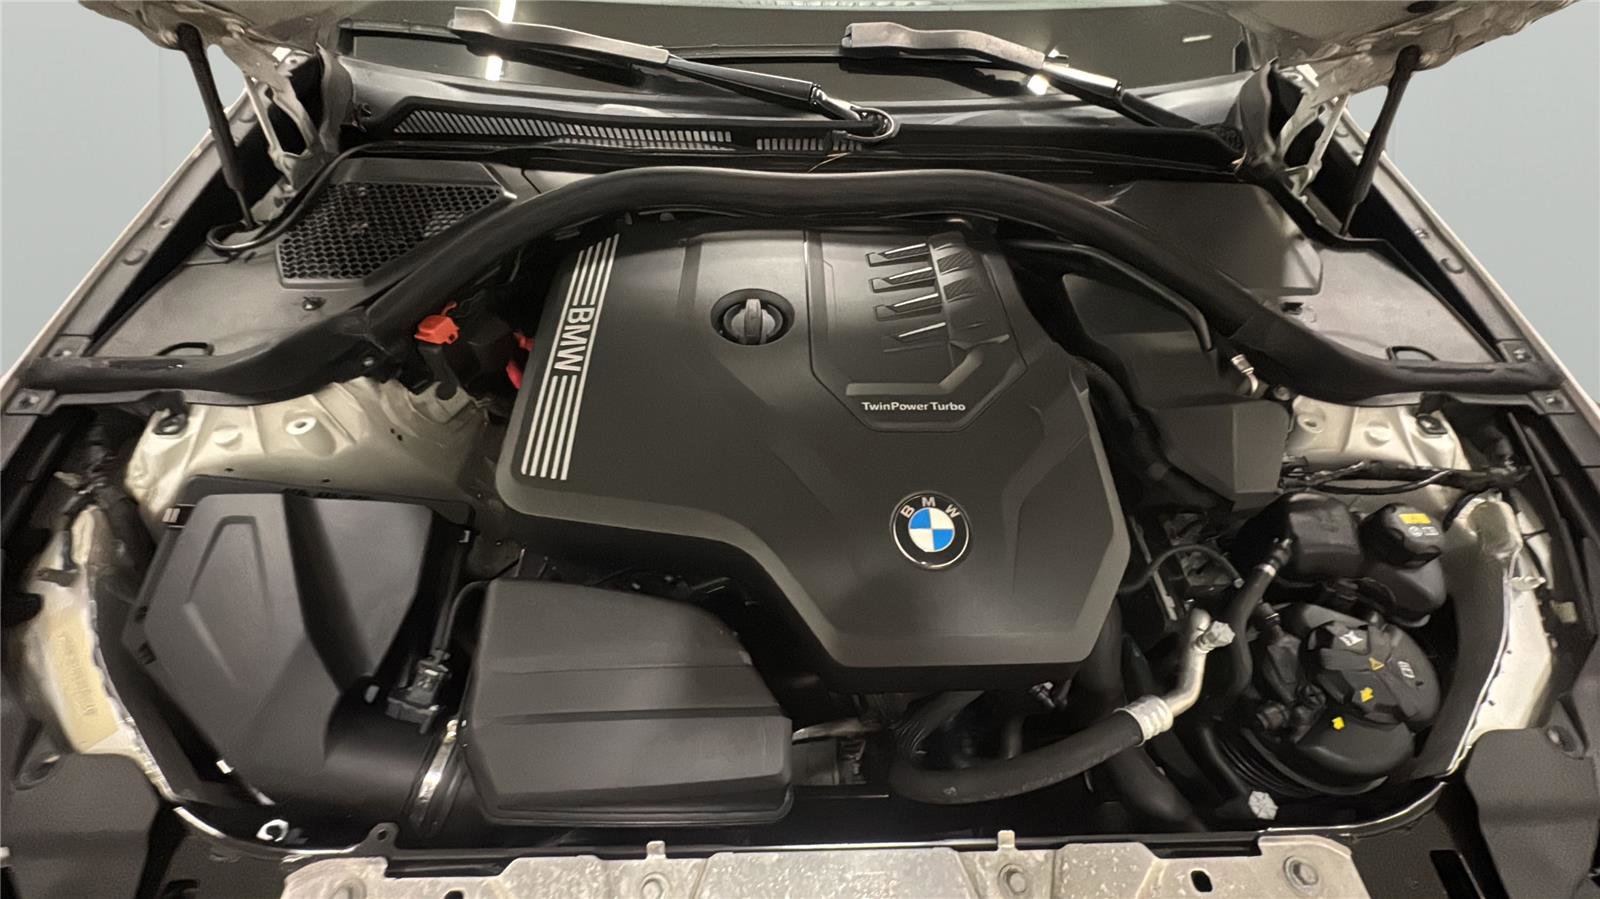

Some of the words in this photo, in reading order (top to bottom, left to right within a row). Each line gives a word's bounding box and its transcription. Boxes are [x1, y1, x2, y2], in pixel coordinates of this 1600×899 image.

[553, 307, 596, 372] BMW
[861, 401, 929, 411] TwinPower
[930, 401, 966, 411] Turbo
[900, 496, 960, 518] BMW
